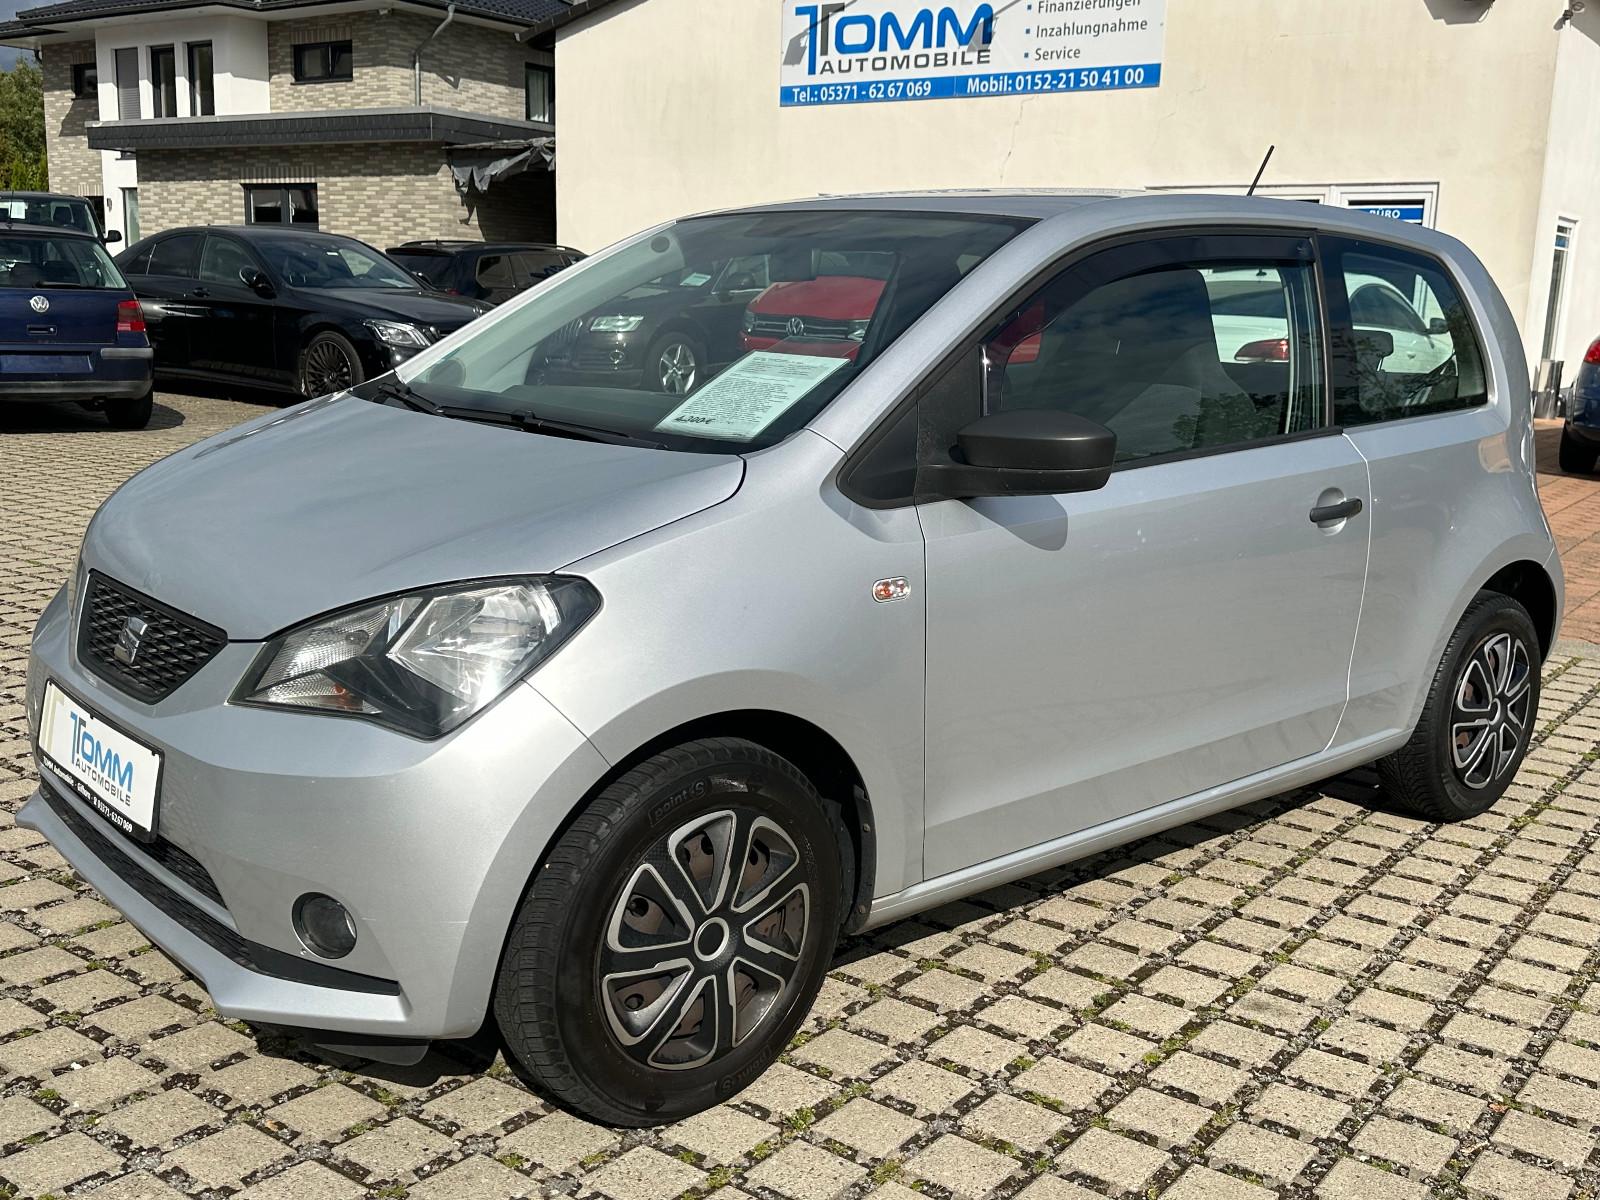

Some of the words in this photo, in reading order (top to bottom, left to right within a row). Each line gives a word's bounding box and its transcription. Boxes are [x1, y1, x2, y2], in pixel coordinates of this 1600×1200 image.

[1037, 0, 1142, 14] Finanzierungen
[795, 2, 994, 76] TOMM
[1036, 18, 1149, 38] Inzahlungnahme
[819, 49, 991, 75] AUTOMOBILE
[1034, 46, 1081, 62] Service
[792, 87, 818, 103] Tel.:
[820, 84, 858, 102] 05371
[868, 83, 885, 99] 62
[887, 82, 903, 98] 67
[906, 80, 932, 97] 069
[966, 76, 1012, 94] Mobil:
[1015, 73, 1075, 91] 0152-21
[1079, 70, 1098, 88] 50
[1101, 69, 1119, 86] 41
[1124, 67, 1144, 84] 00
[70, 711, 134, 793] TOMM
[75, 757, 132, 807] AUTOMOBILE
